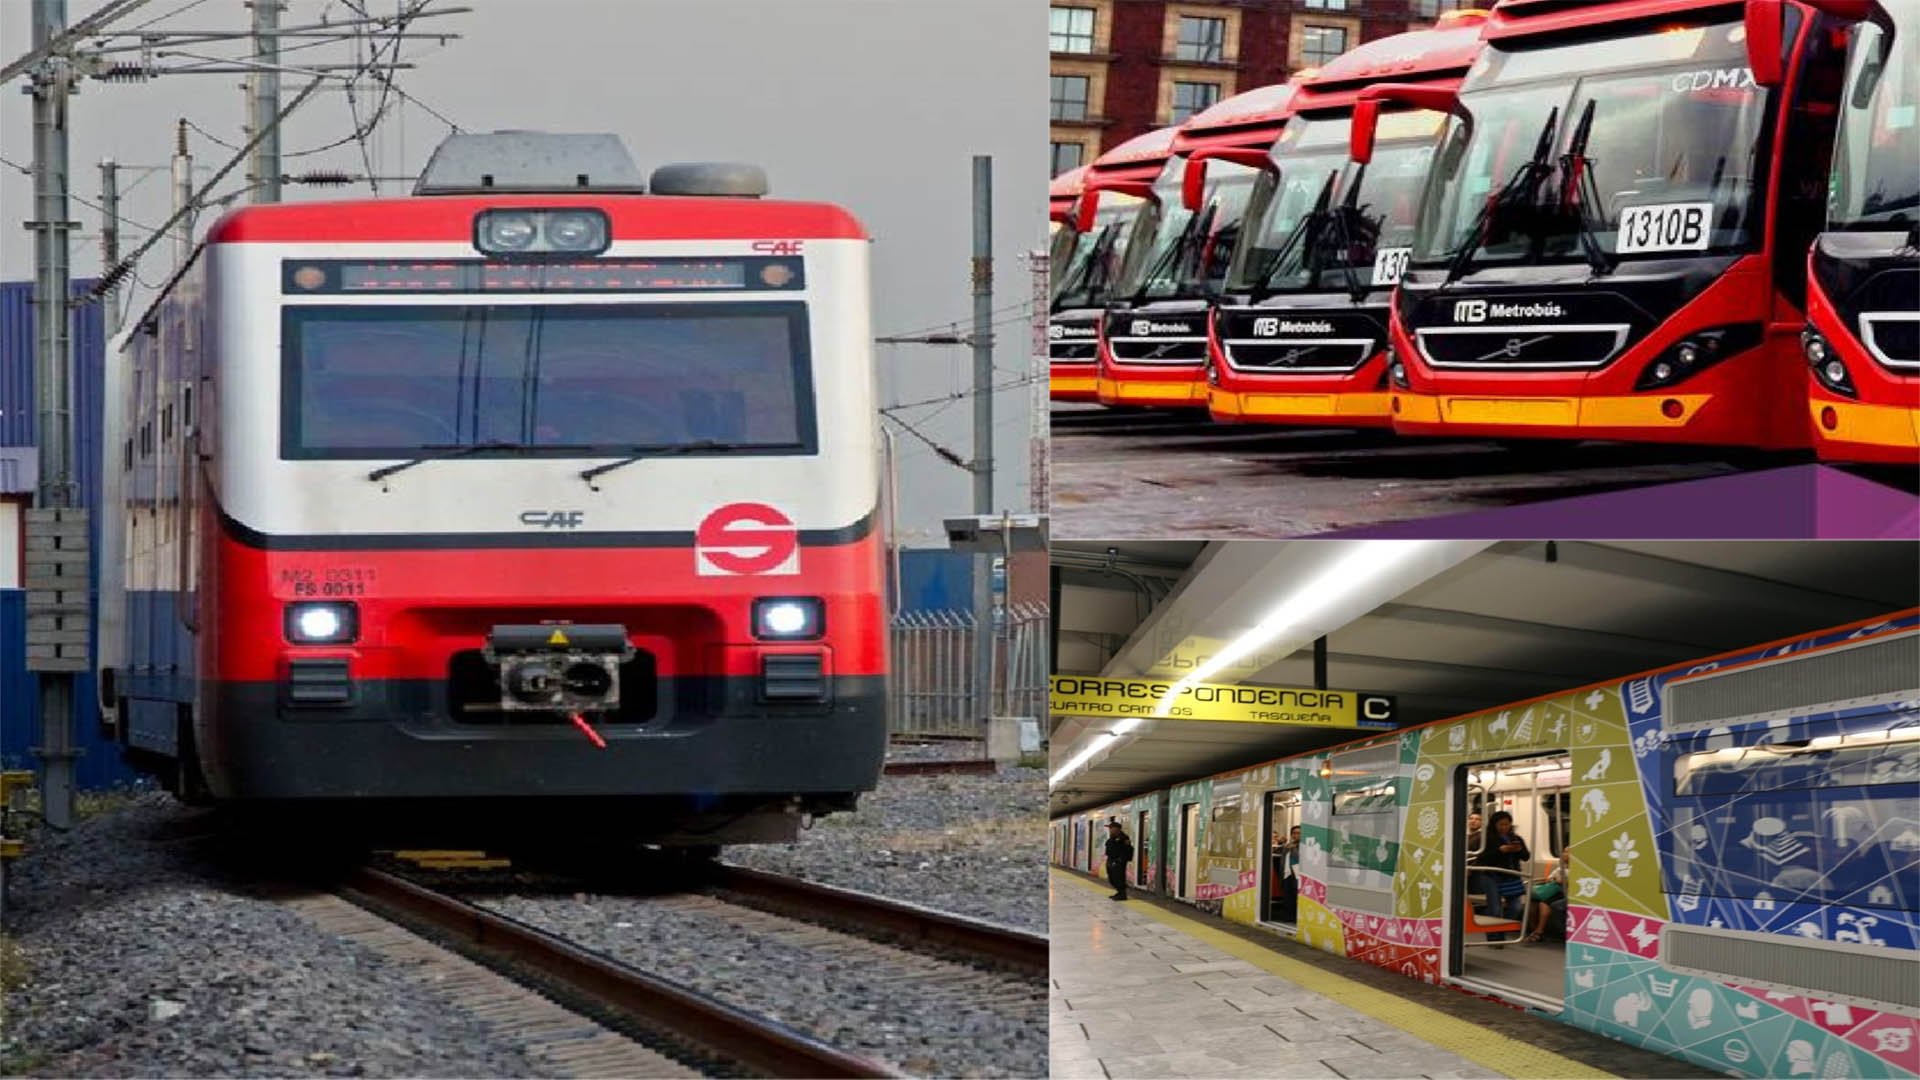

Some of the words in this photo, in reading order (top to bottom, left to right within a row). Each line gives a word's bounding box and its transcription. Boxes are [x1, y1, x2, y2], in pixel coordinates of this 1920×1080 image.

[1672, 67, 1757, 93] CDMX
[1625, 208, 1704, 248] 1310B
[752, 241, 803, 255] CAF
[1489, 301, 1563, 318] Metrobús
[1279, 320, 1332, 333] Metrobús
[519, 512, 584, 528] CAF
[1250, 711, 1332, 722] TASQUEÑA
[1364, 698, 1390, 719] C
